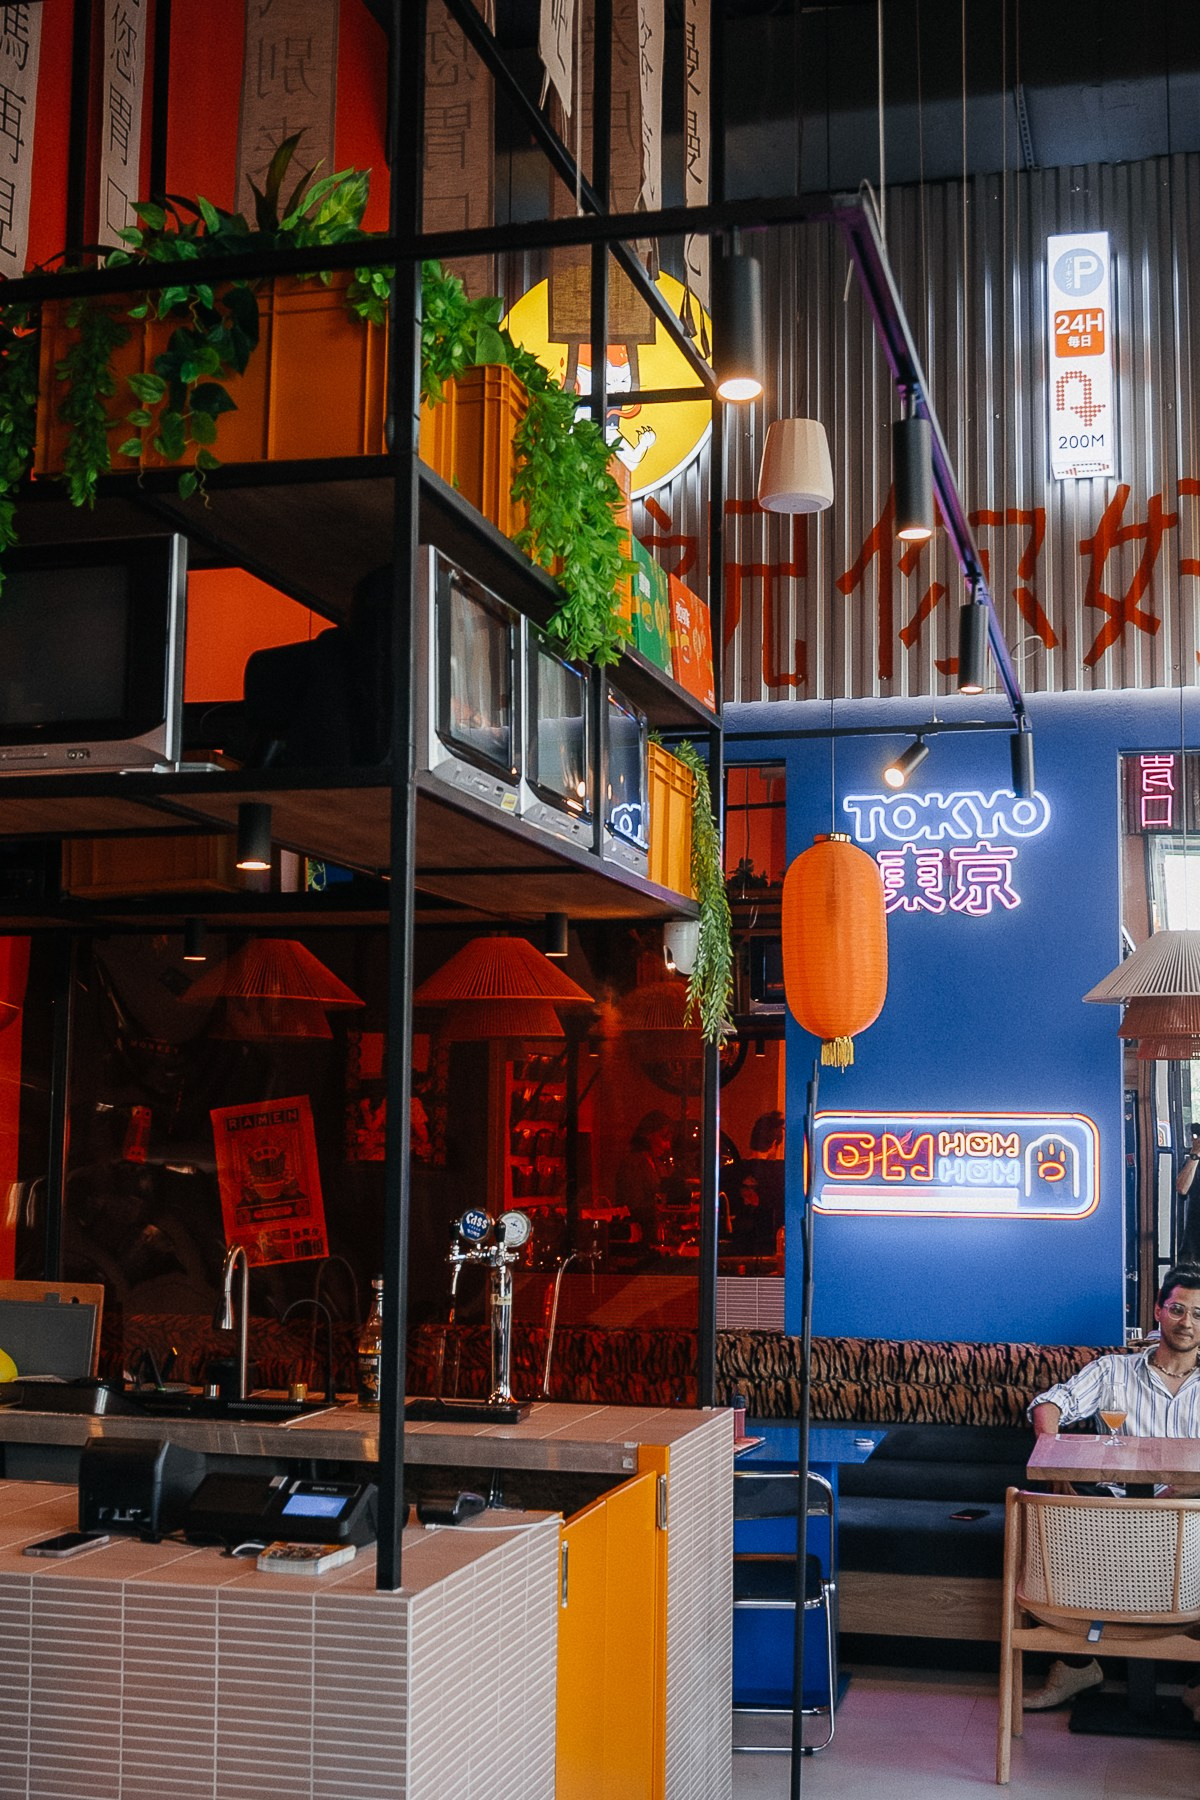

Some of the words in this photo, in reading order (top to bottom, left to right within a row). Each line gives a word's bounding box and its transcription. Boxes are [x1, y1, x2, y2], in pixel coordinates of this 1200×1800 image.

[106, 0, 141, 247] 您胃口
[1065, 257, 1073, 289] パーキング
[1074, 256, 1098, 289] P
[1056, 312, 1103, 335] 24H
[1058, 434, 1104, 449] 200M
[843, 788, 1051, 843] TOKYO
[876, 840, 1022, 914] 東京
[228, 1109, 298, 1129] RAMEN
[466, 1212, 488, 1230] Cass
